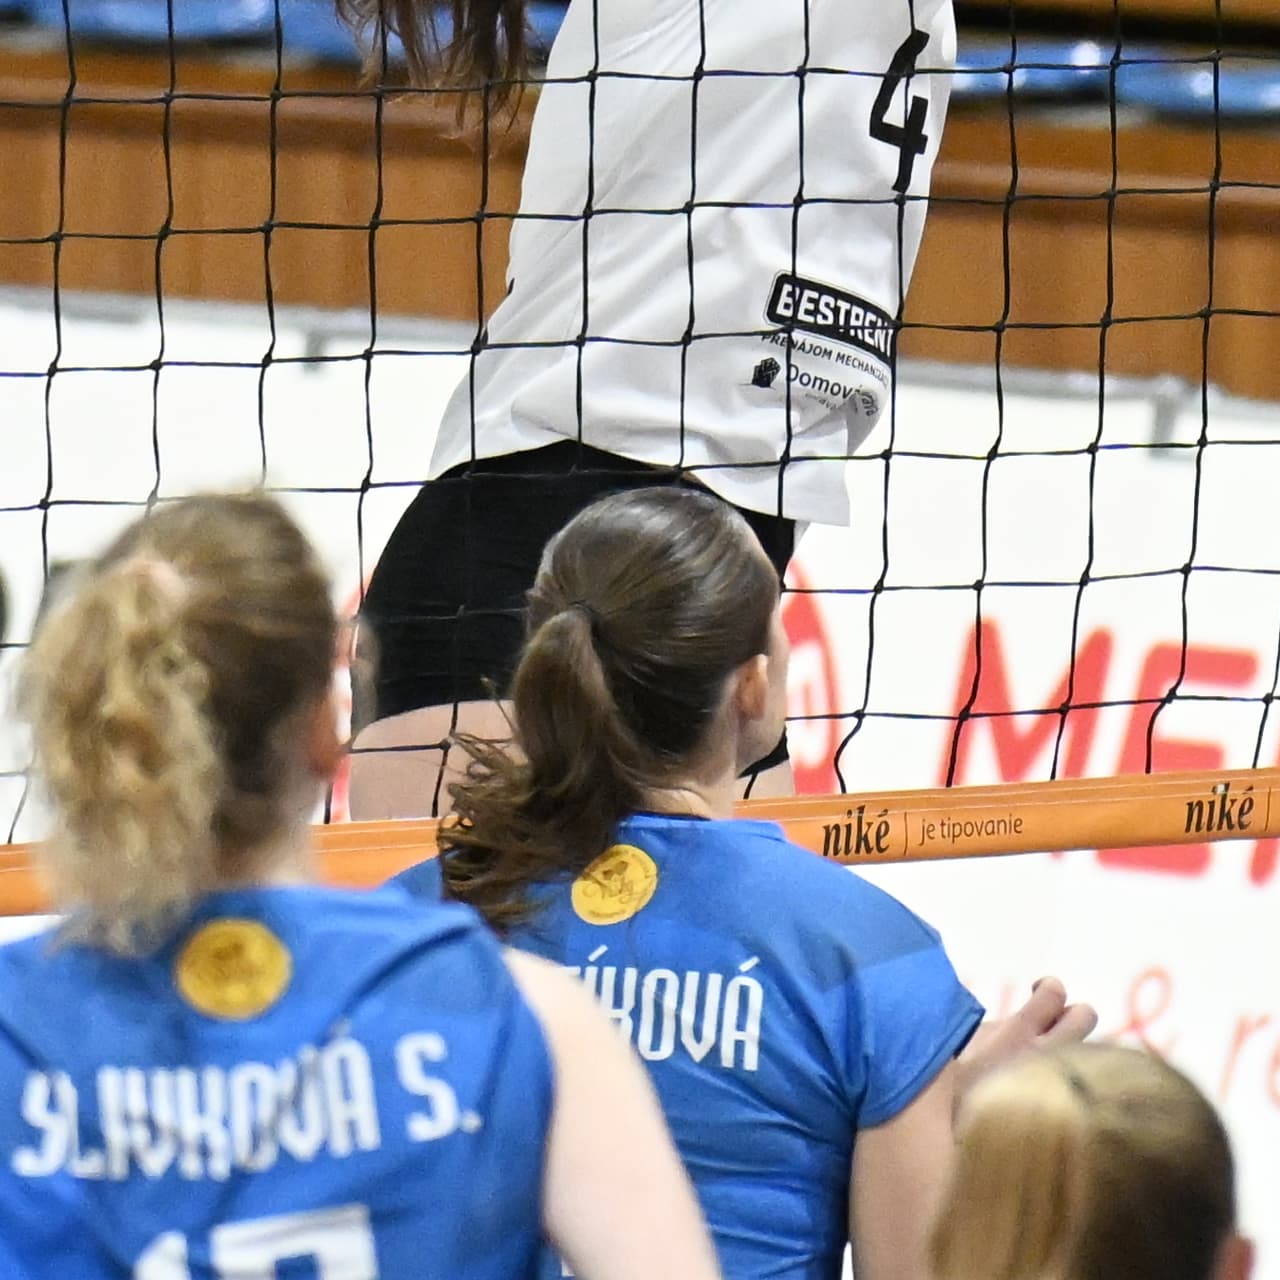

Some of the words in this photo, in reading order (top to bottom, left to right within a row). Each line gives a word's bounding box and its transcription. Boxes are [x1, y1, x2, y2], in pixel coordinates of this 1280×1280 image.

[868, 28, 931, 193] 4
[775, 282, 894, 358] BESTRENT
[822, 804, 890, 857] niké
[918, 819, 936, 847] je
[939, 813, 1024, 844] tipovanie
[1183, 781, 1255, 833] niké
[393, 1031, 483, 1144] S.
